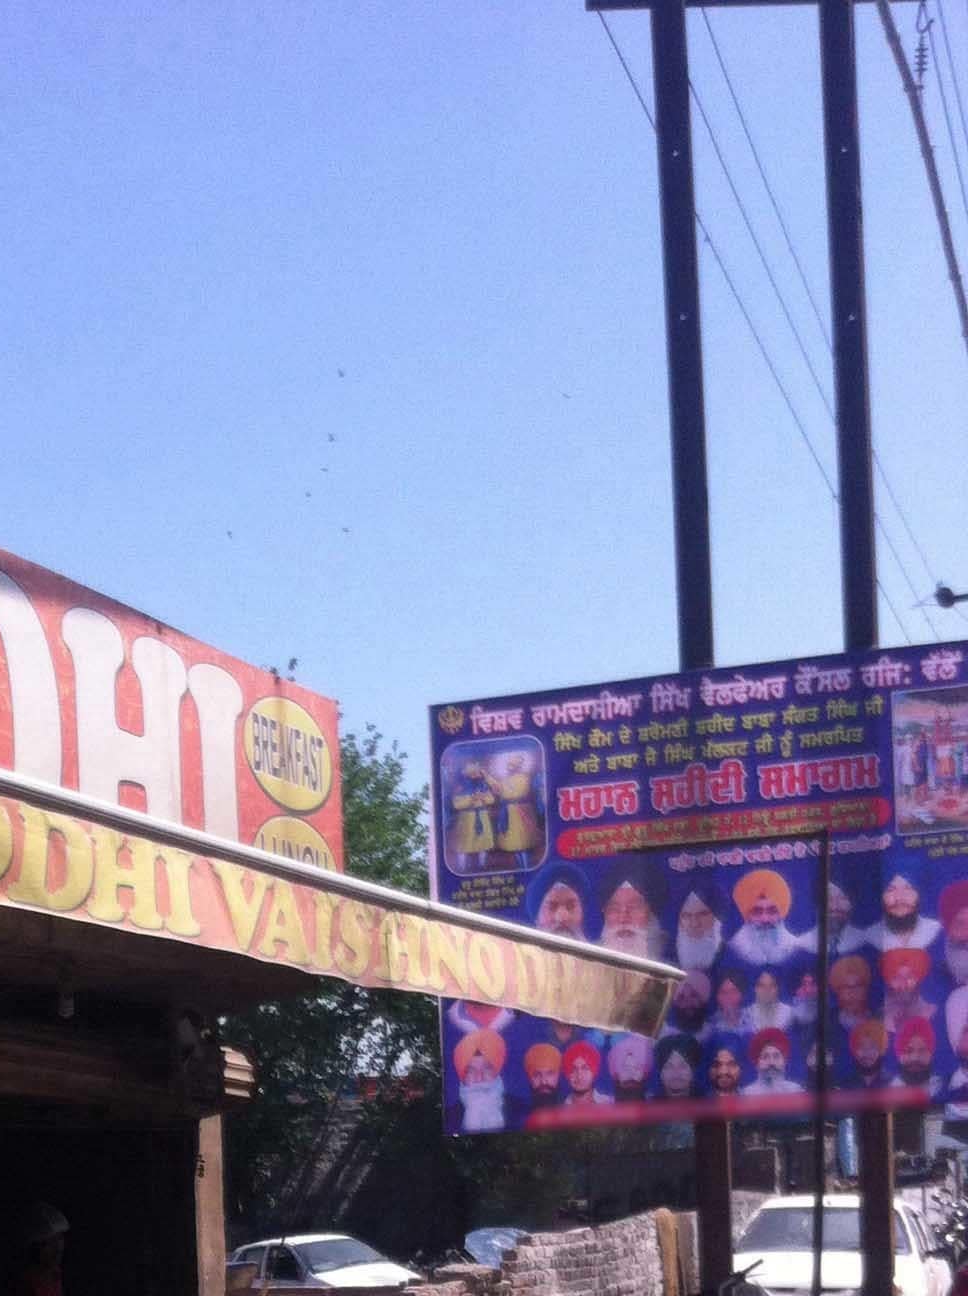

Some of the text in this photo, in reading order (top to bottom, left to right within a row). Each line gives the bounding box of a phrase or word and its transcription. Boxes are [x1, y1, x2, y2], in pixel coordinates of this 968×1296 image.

[649, 681, 692, 713] ਸਿੱਖ
[251, 711, 326, 794] BREAKFAST
[557, 780, 641, 821] ਮਹਾਨ
[757, 752, 881, 800] ਸਮਾਗਮ
[210, 856, 507, 998] VAISHNO
